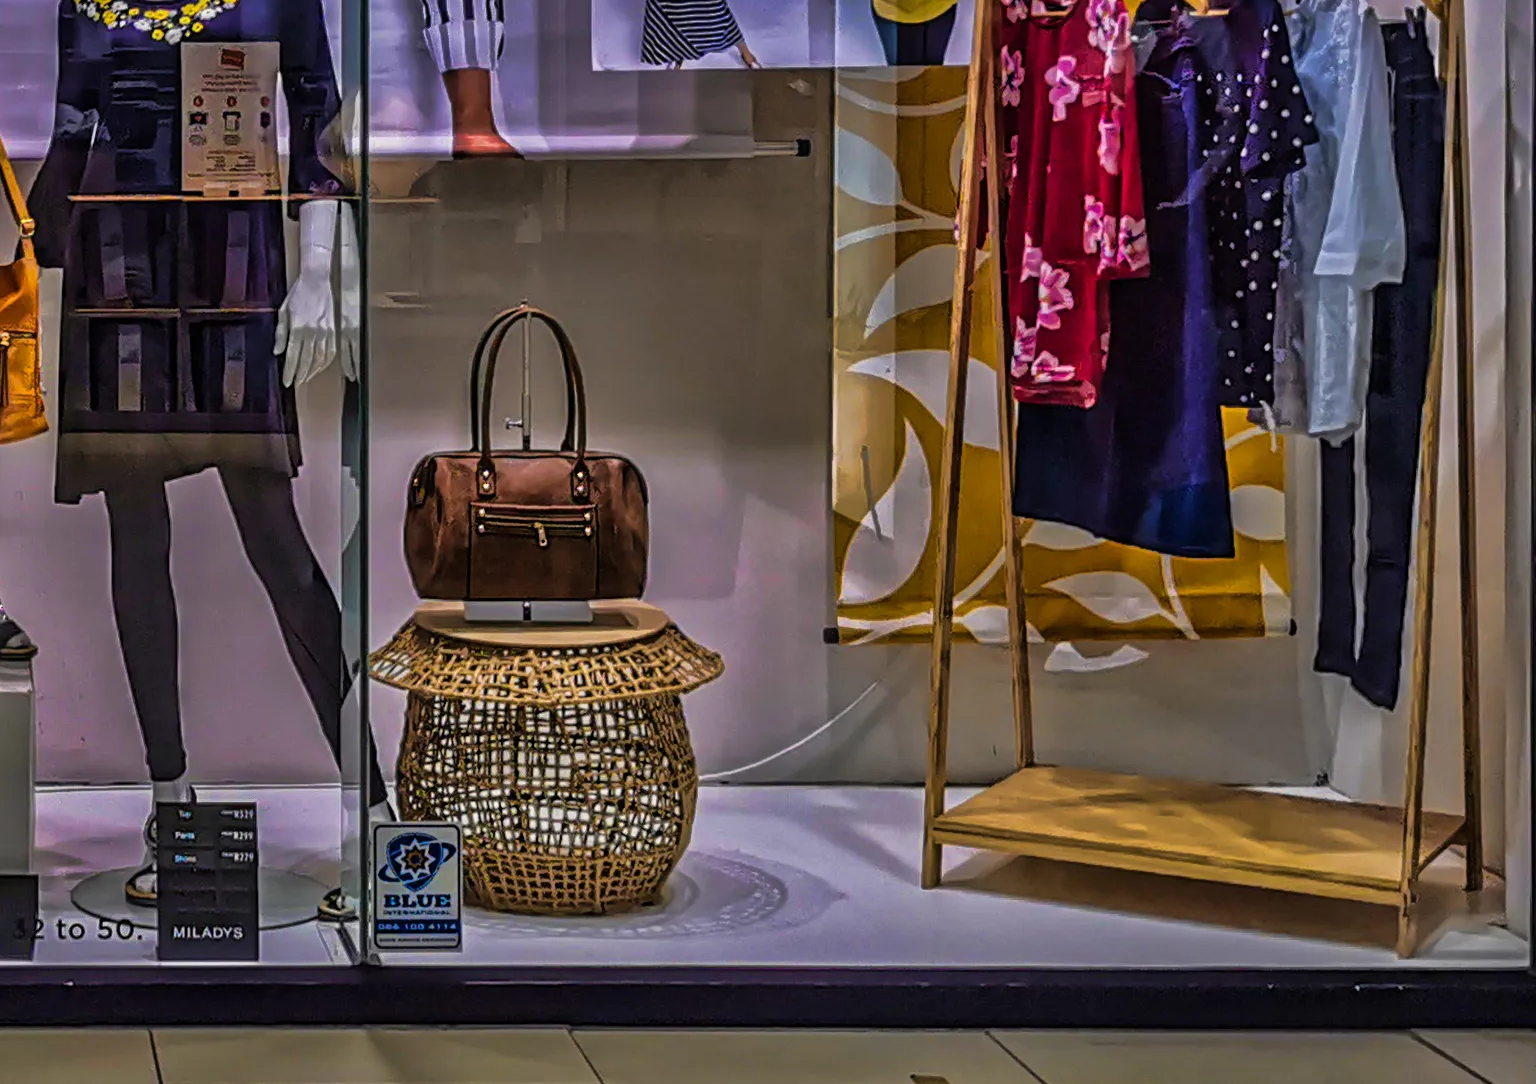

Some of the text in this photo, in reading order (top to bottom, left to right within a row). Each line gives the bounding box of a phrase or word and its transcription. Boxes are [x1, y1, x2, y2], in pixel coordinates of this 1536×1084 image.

[384, 894, 451, 907] BLUE
[56, 919, 86, 941] to
[97, 919, 143, 941] 50.
[173, 926, 244, 940] MILADYS
